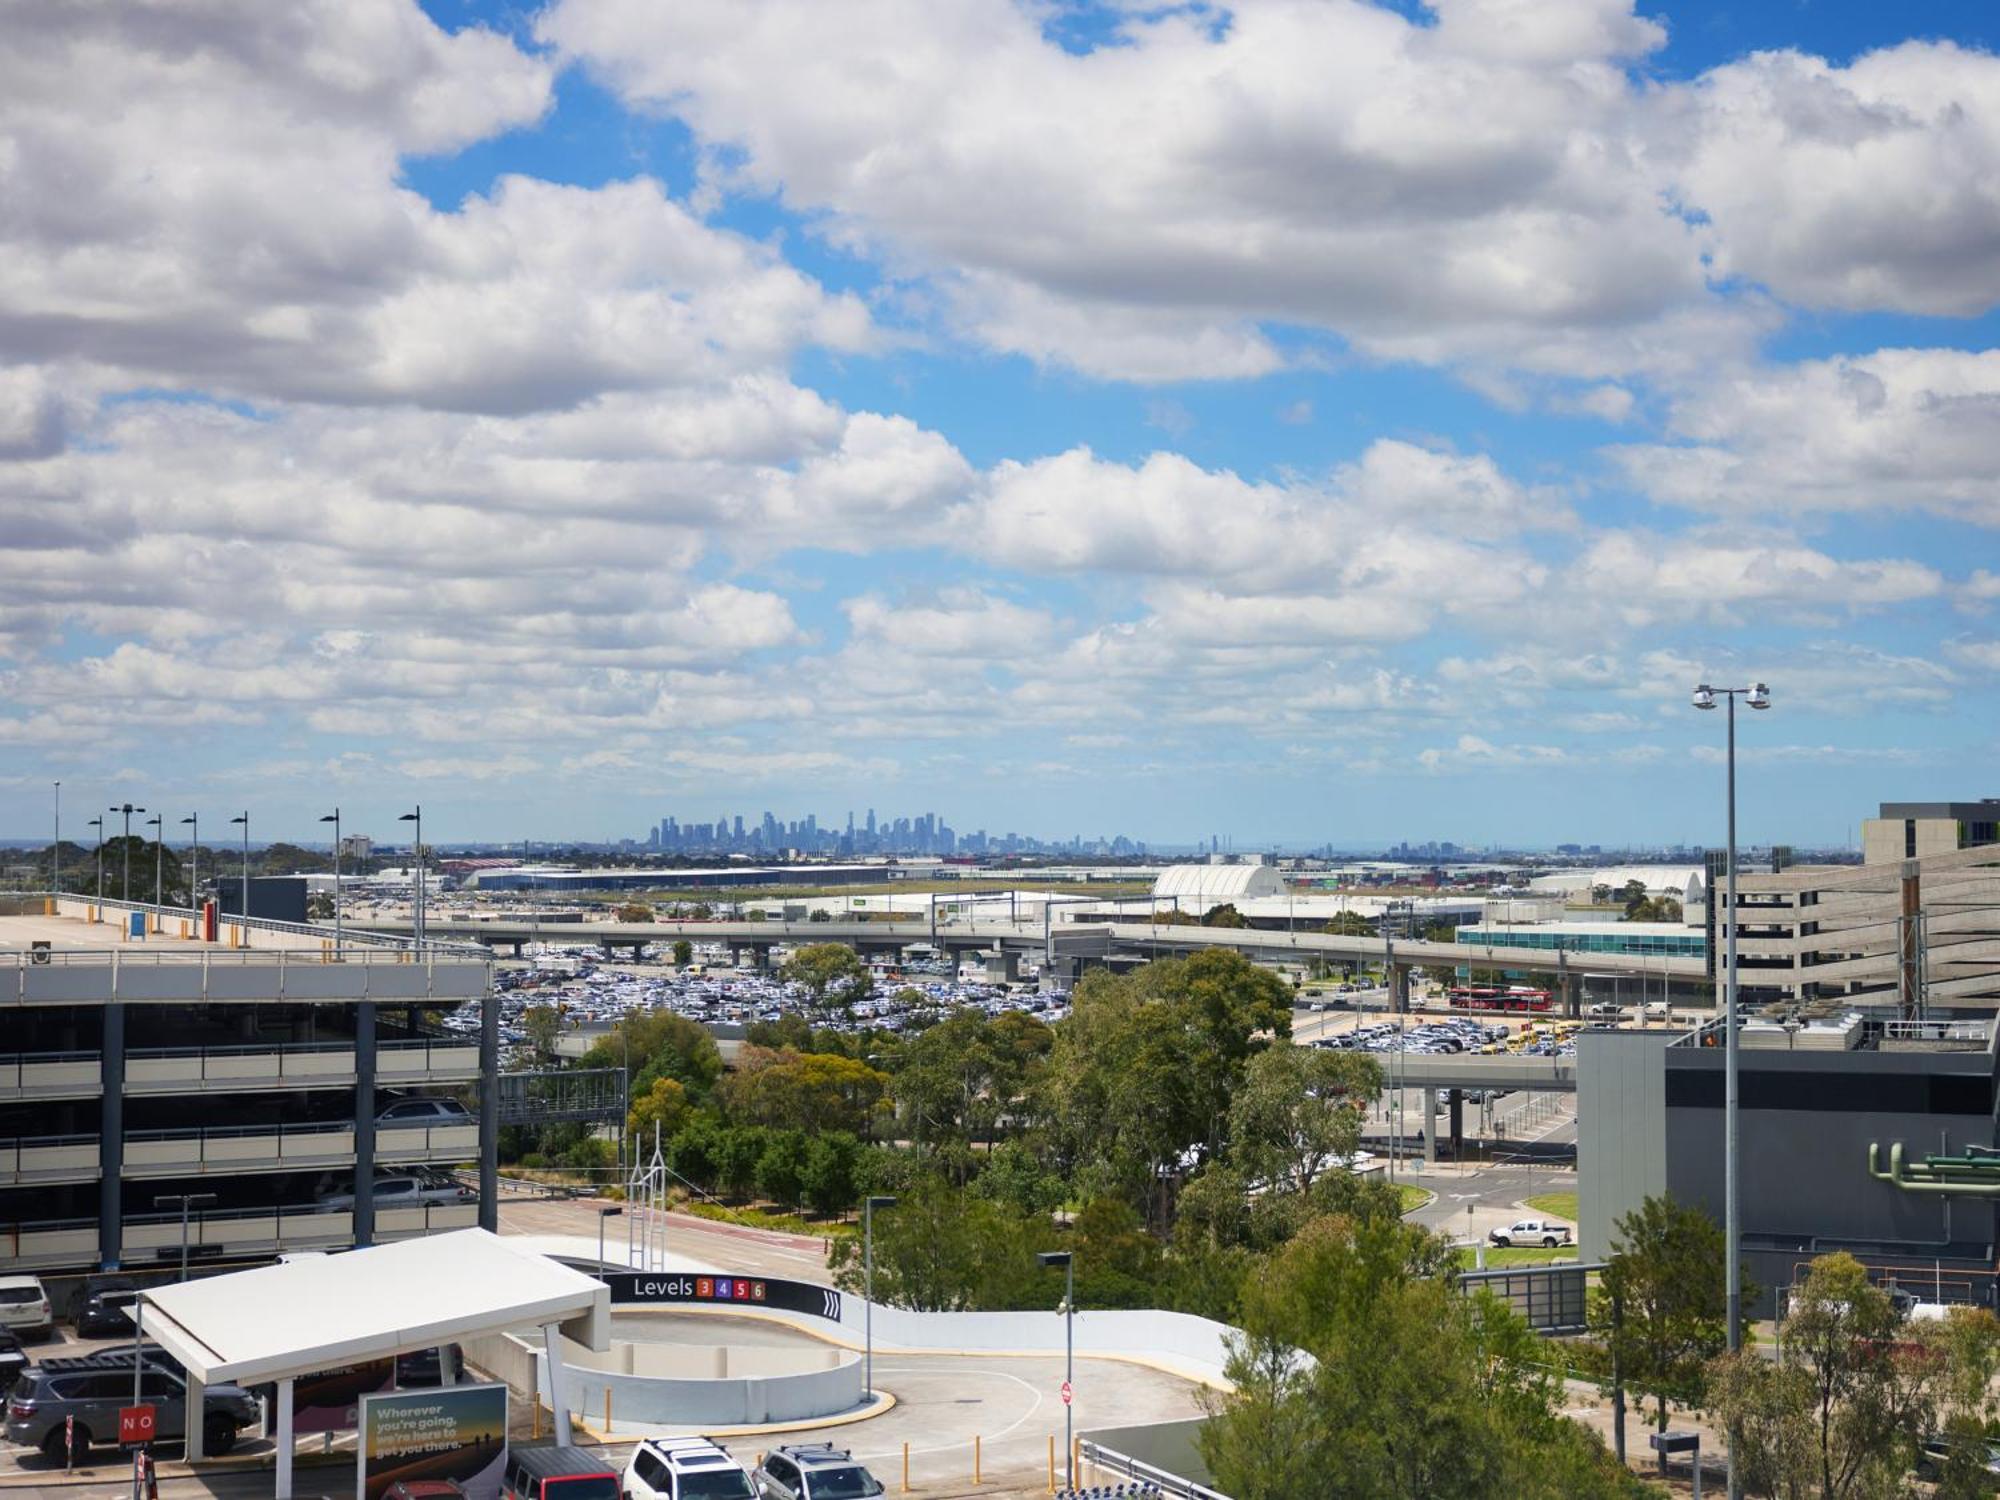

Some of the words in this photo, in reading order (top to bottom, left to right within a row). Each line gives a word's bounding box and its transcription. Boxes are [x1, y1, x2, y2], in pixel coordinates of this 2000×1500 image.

[634, 1277, 693, 1296] Levels
[701, 1280, 710, 1294] 3
[718, 1280, 728, 1295] 4
[737, 1283, 745, 1297] 5
[754, 1284, 762, 1297] 6
[376, 1405, 443, 1419] Wherever
[377, 1420, 417, 1434] you're
[419, 1416, 457, 1430] going,
[412, 1430, 442, 1440] here
[443, 1428, 457, 1438] to
[376, 1447, 399, 1460] get
[399, 1445, 424, 1457] you
[424, 1440, 463, 1453] there.
